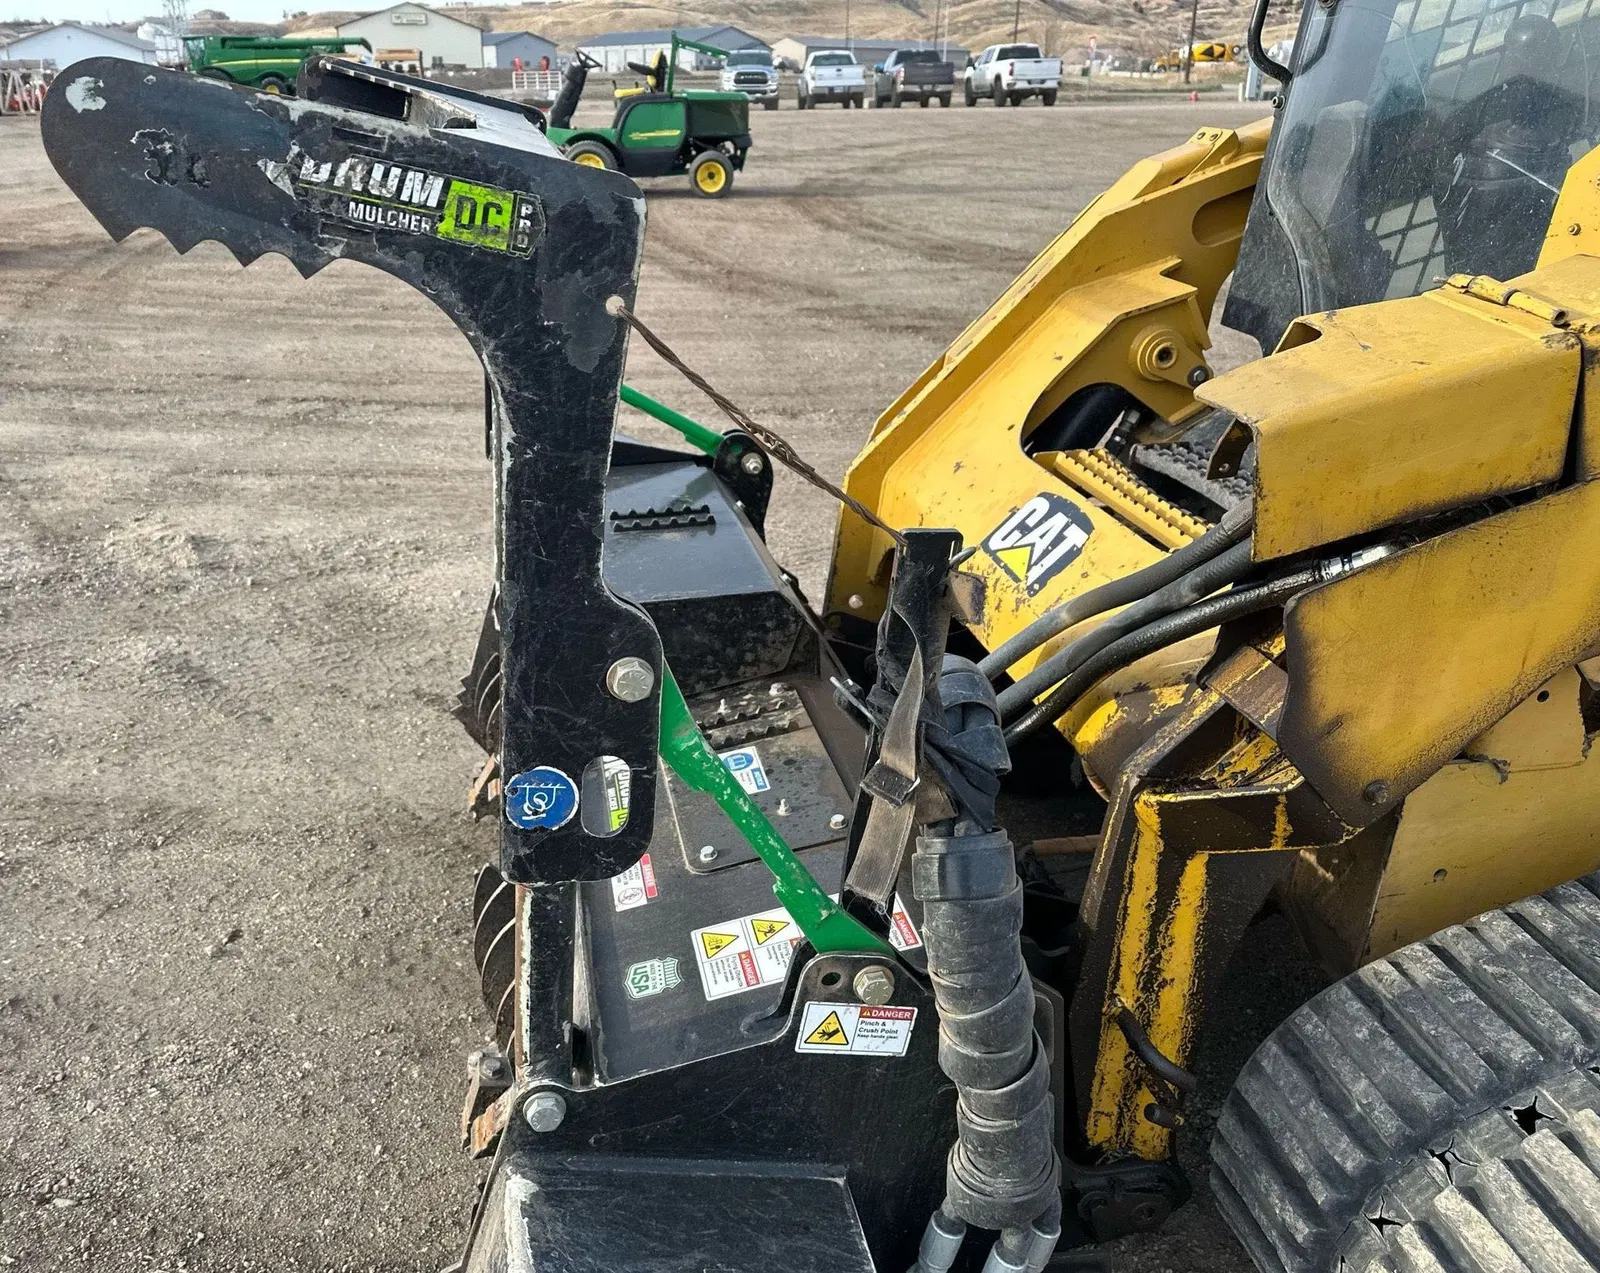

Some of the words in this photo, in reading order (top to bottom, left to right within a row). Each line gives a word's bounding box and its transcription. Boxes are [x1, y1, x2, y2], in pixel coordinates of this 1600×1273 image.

[349, 201, 431, 233] MULCHER
[454, 194, 503, 232] DC
[988, 496, 1089, 586] CAT
[896, 918, 914, 944] DANGER
[631, 965, 650, 993] USA
[729, 955, 739, 970] Flying
[734, 969, 744, 987] Objects
[744, 959, 756, 985] DANGER
[872, 1010, 911, 1019] DANGER
